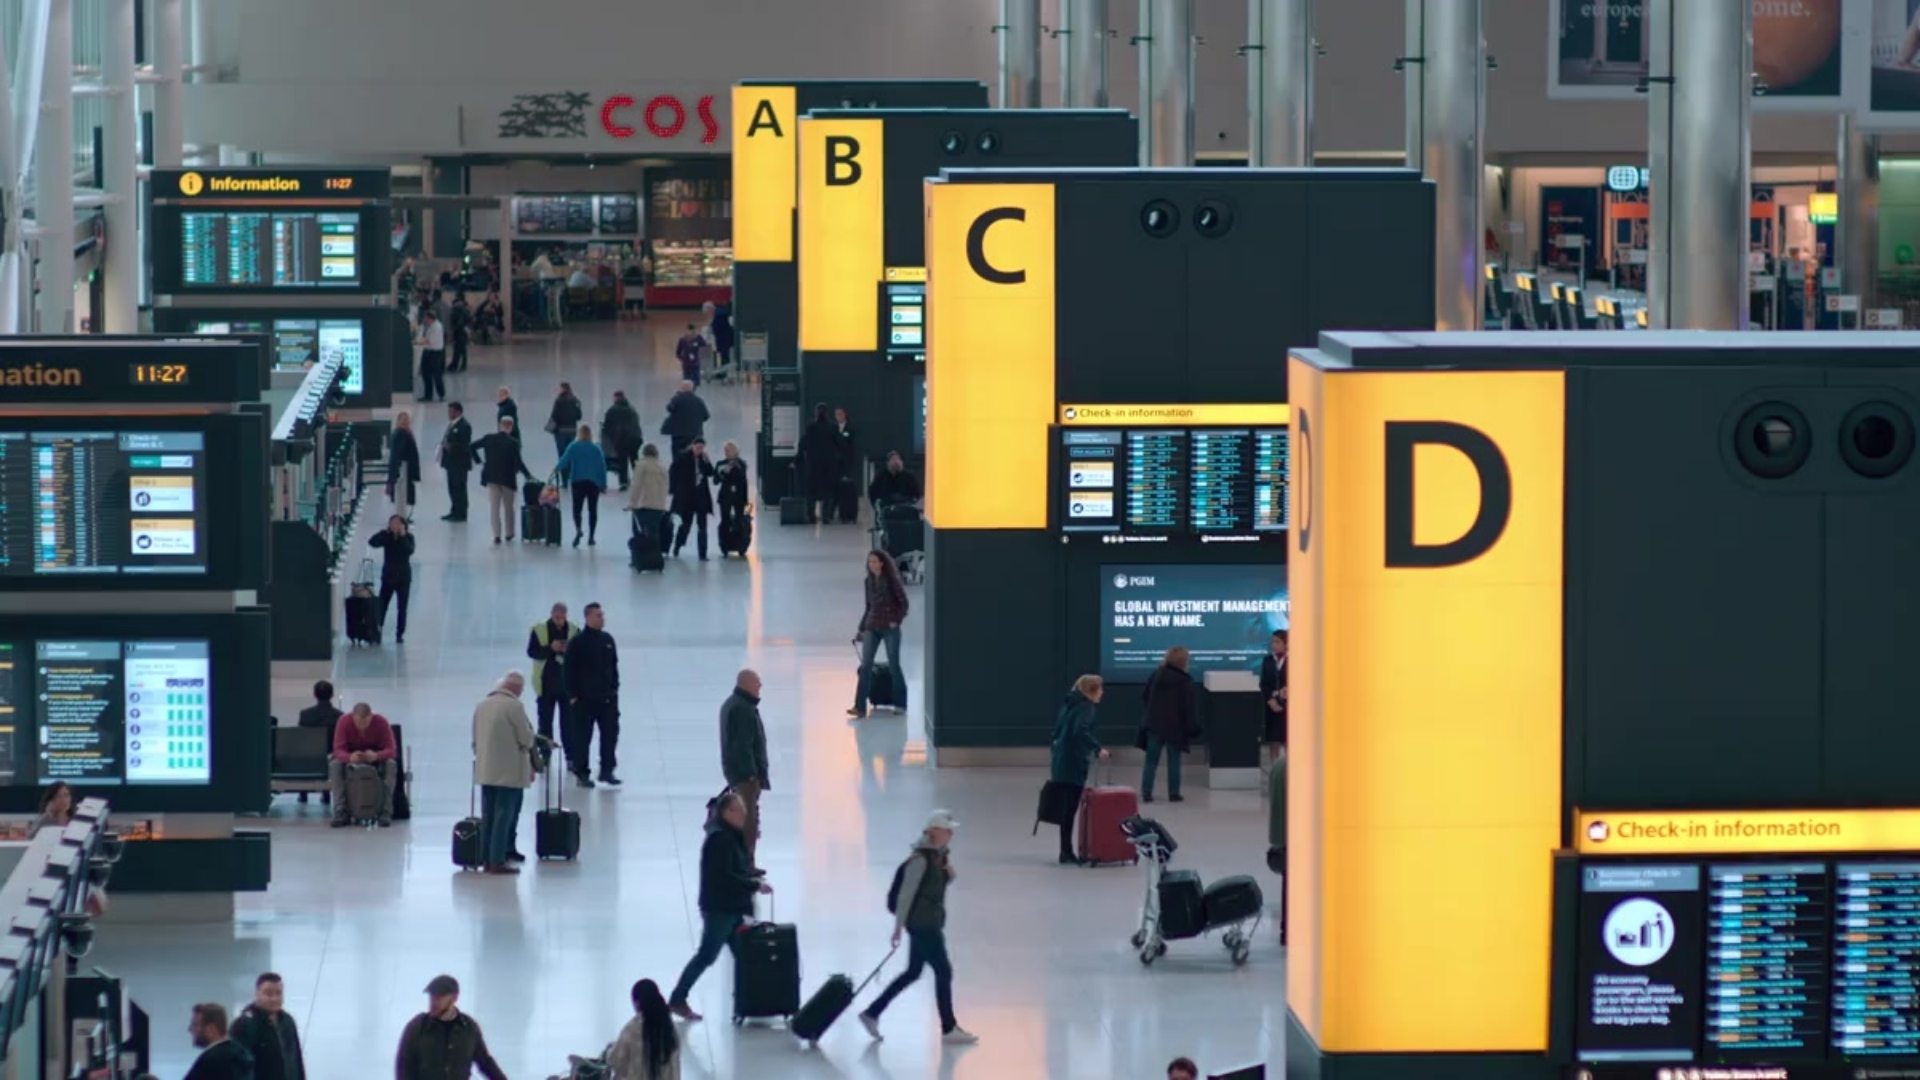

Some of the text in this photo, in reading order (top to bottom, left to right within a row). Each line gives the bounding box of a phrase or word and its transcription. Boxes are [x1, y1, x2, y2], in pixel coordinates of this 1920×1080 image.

[1752, 0, 1811, 17] ome.
[746, 100, 784, 137] A
[825, 136, 862, 186] B
[210, 177, 300, 191] Information
[325, 178, 353, 190] 11:27
[966, 206, 1026, 285] C
[0, 363, 82, 386] ation
[136, 365, 188, 383] 11:27
[1079, 408, 1193, 418] Check-in information
[1384, 420, 1512, 568] D
[1129, 576, 1155, 586] PGIM
[1114, 600, 1154, 612] GLOBAL
[1156, 600, 1220, 612] INVESTMENT
[1114, 614, 1205, 627] HAS A NEW NAME.
[1617, 819, 1841, 838] Check-in information
